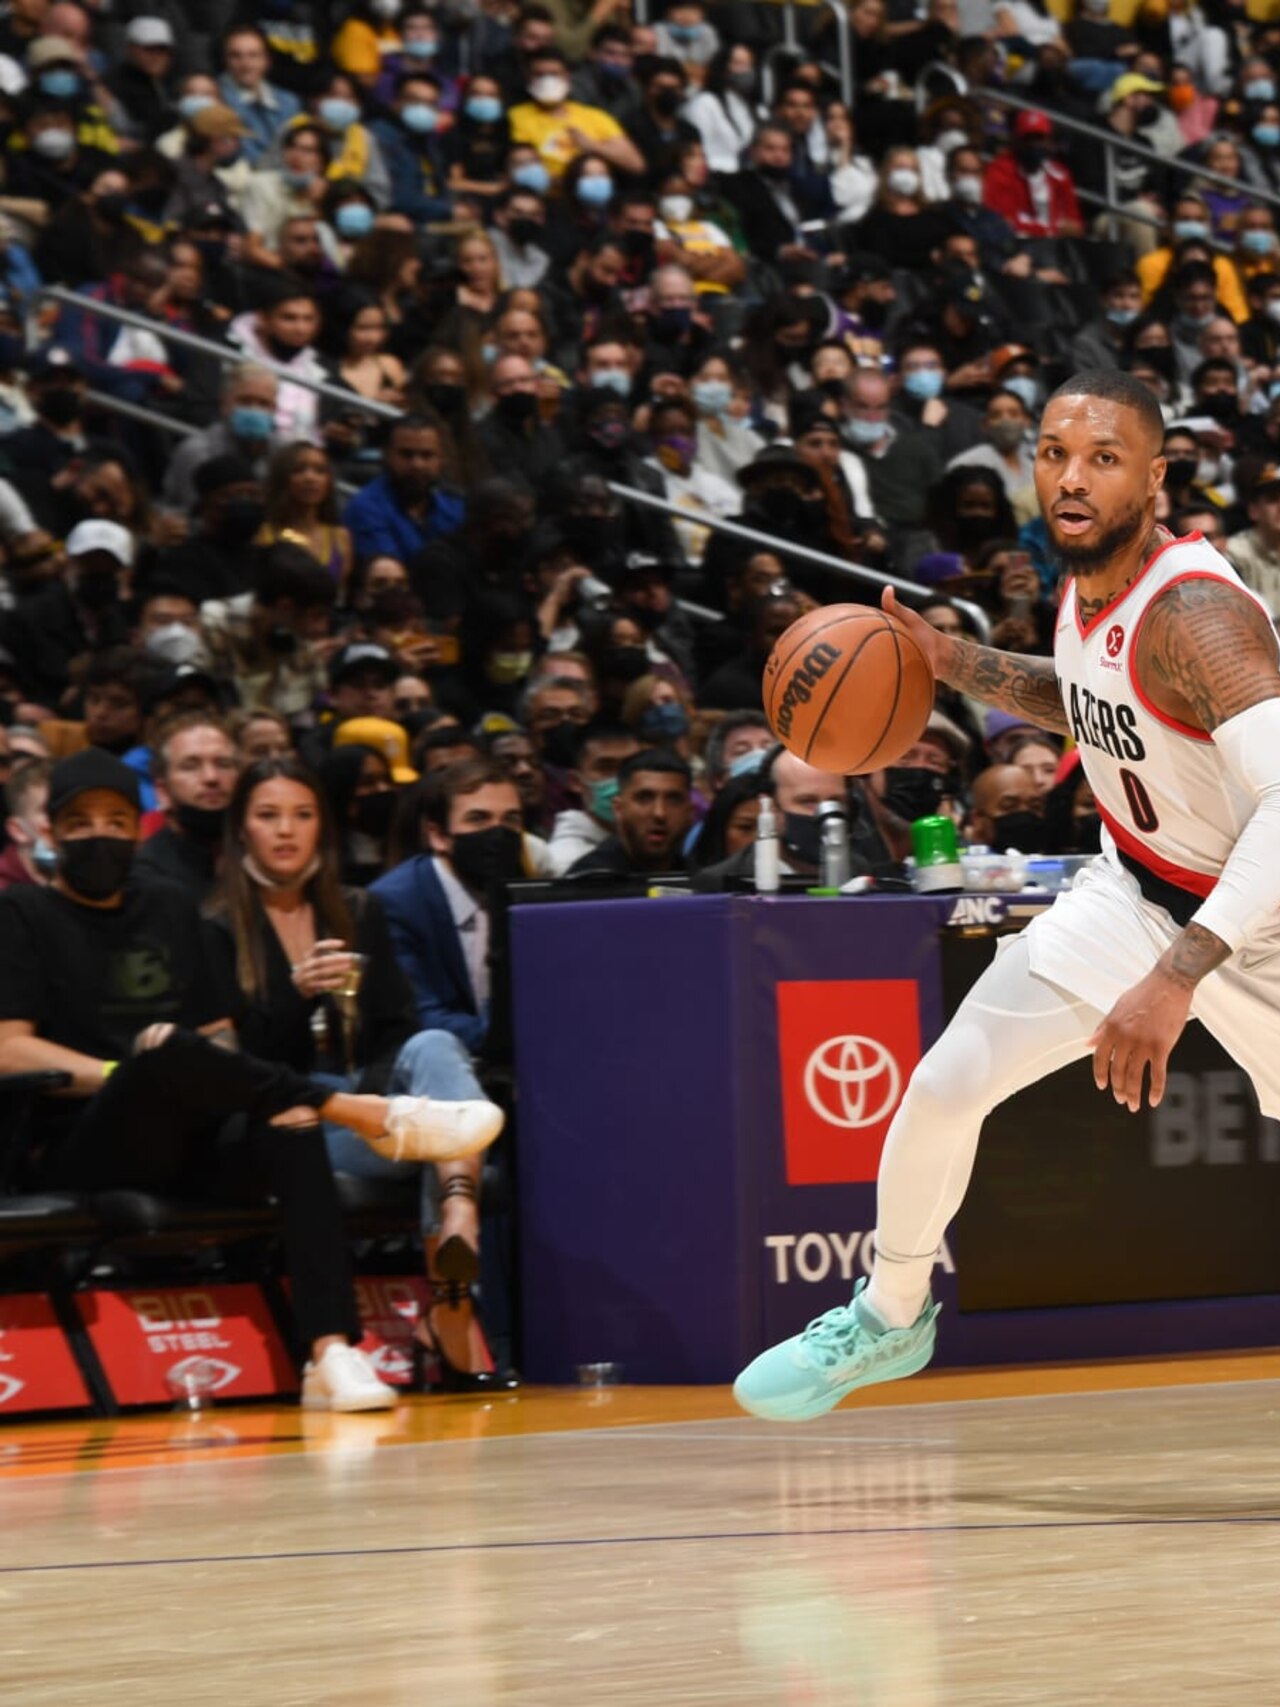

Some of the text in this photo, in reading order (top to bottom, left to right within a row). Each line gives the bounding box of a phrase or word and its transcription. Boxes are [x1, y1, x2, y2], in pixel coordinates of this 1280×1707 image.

[777, 643, 842, 740] Wilson
[1058, 677, 1146, 761] AZERS
[1119, 767, 1159, 833] 0
[946, 897, 1005, 926] ANC
[131, 1292, 222, 1333] BIO
[146, 1332, 232, 1354] STEEL
